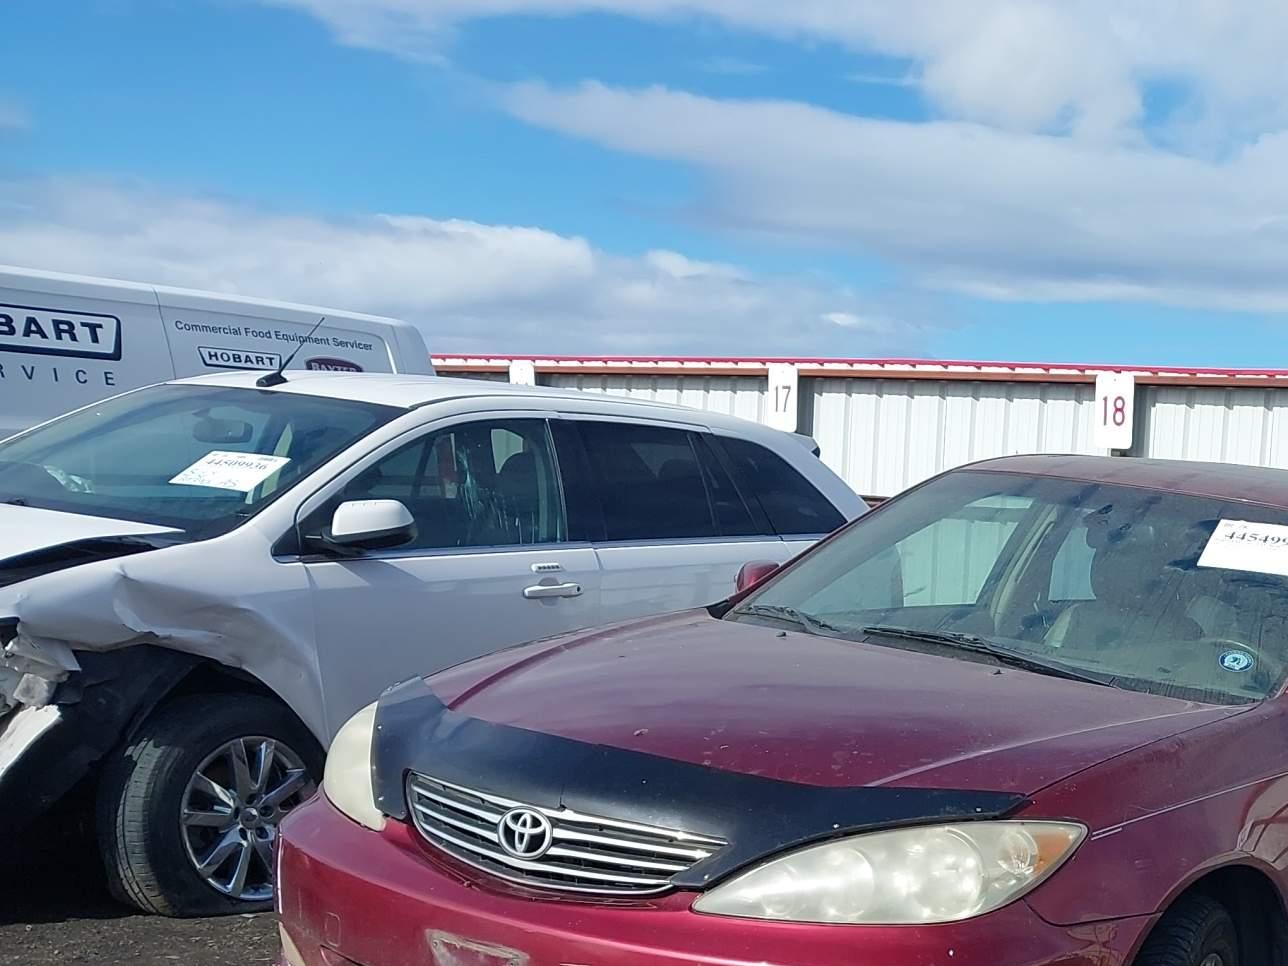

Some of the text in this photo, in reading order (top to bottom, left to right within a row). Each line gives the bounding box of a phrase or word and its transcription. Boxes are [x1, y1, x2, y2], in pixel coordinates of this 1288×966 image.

[175, 320, 373, 351] Commercial Food Equipment Servicer
[207, 351, 275, 366] HOBART
[775, 385, 791, 412] 17
[1103, 396, 1125, 426] 18
